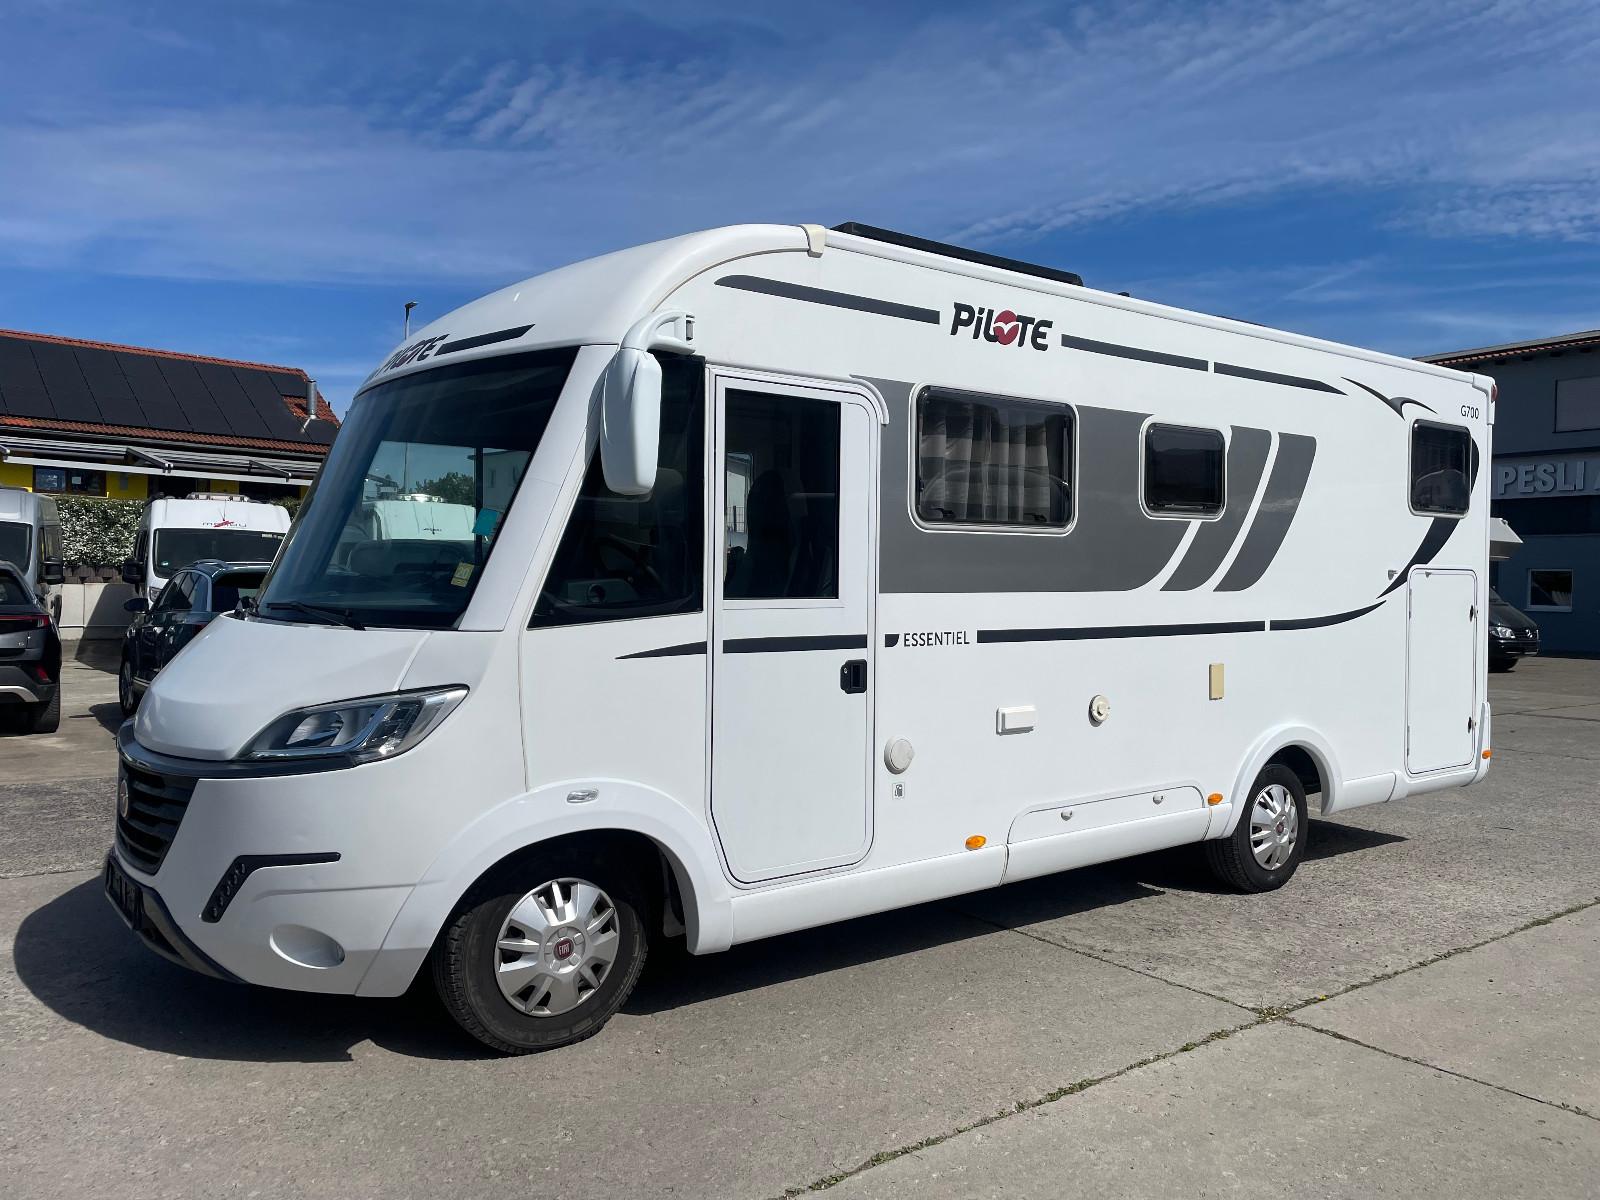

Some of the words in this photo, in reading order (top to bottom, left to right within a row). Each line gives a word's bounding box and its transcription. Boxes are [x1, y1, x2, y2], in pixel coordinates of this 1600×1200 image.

[1461, 405, 1480, 420] G700
[1498, 461, 1585, 495] PESLI
[903, 631, 970, 647] ESSENTIEL
[559, 942, 570, 955] FIAT
